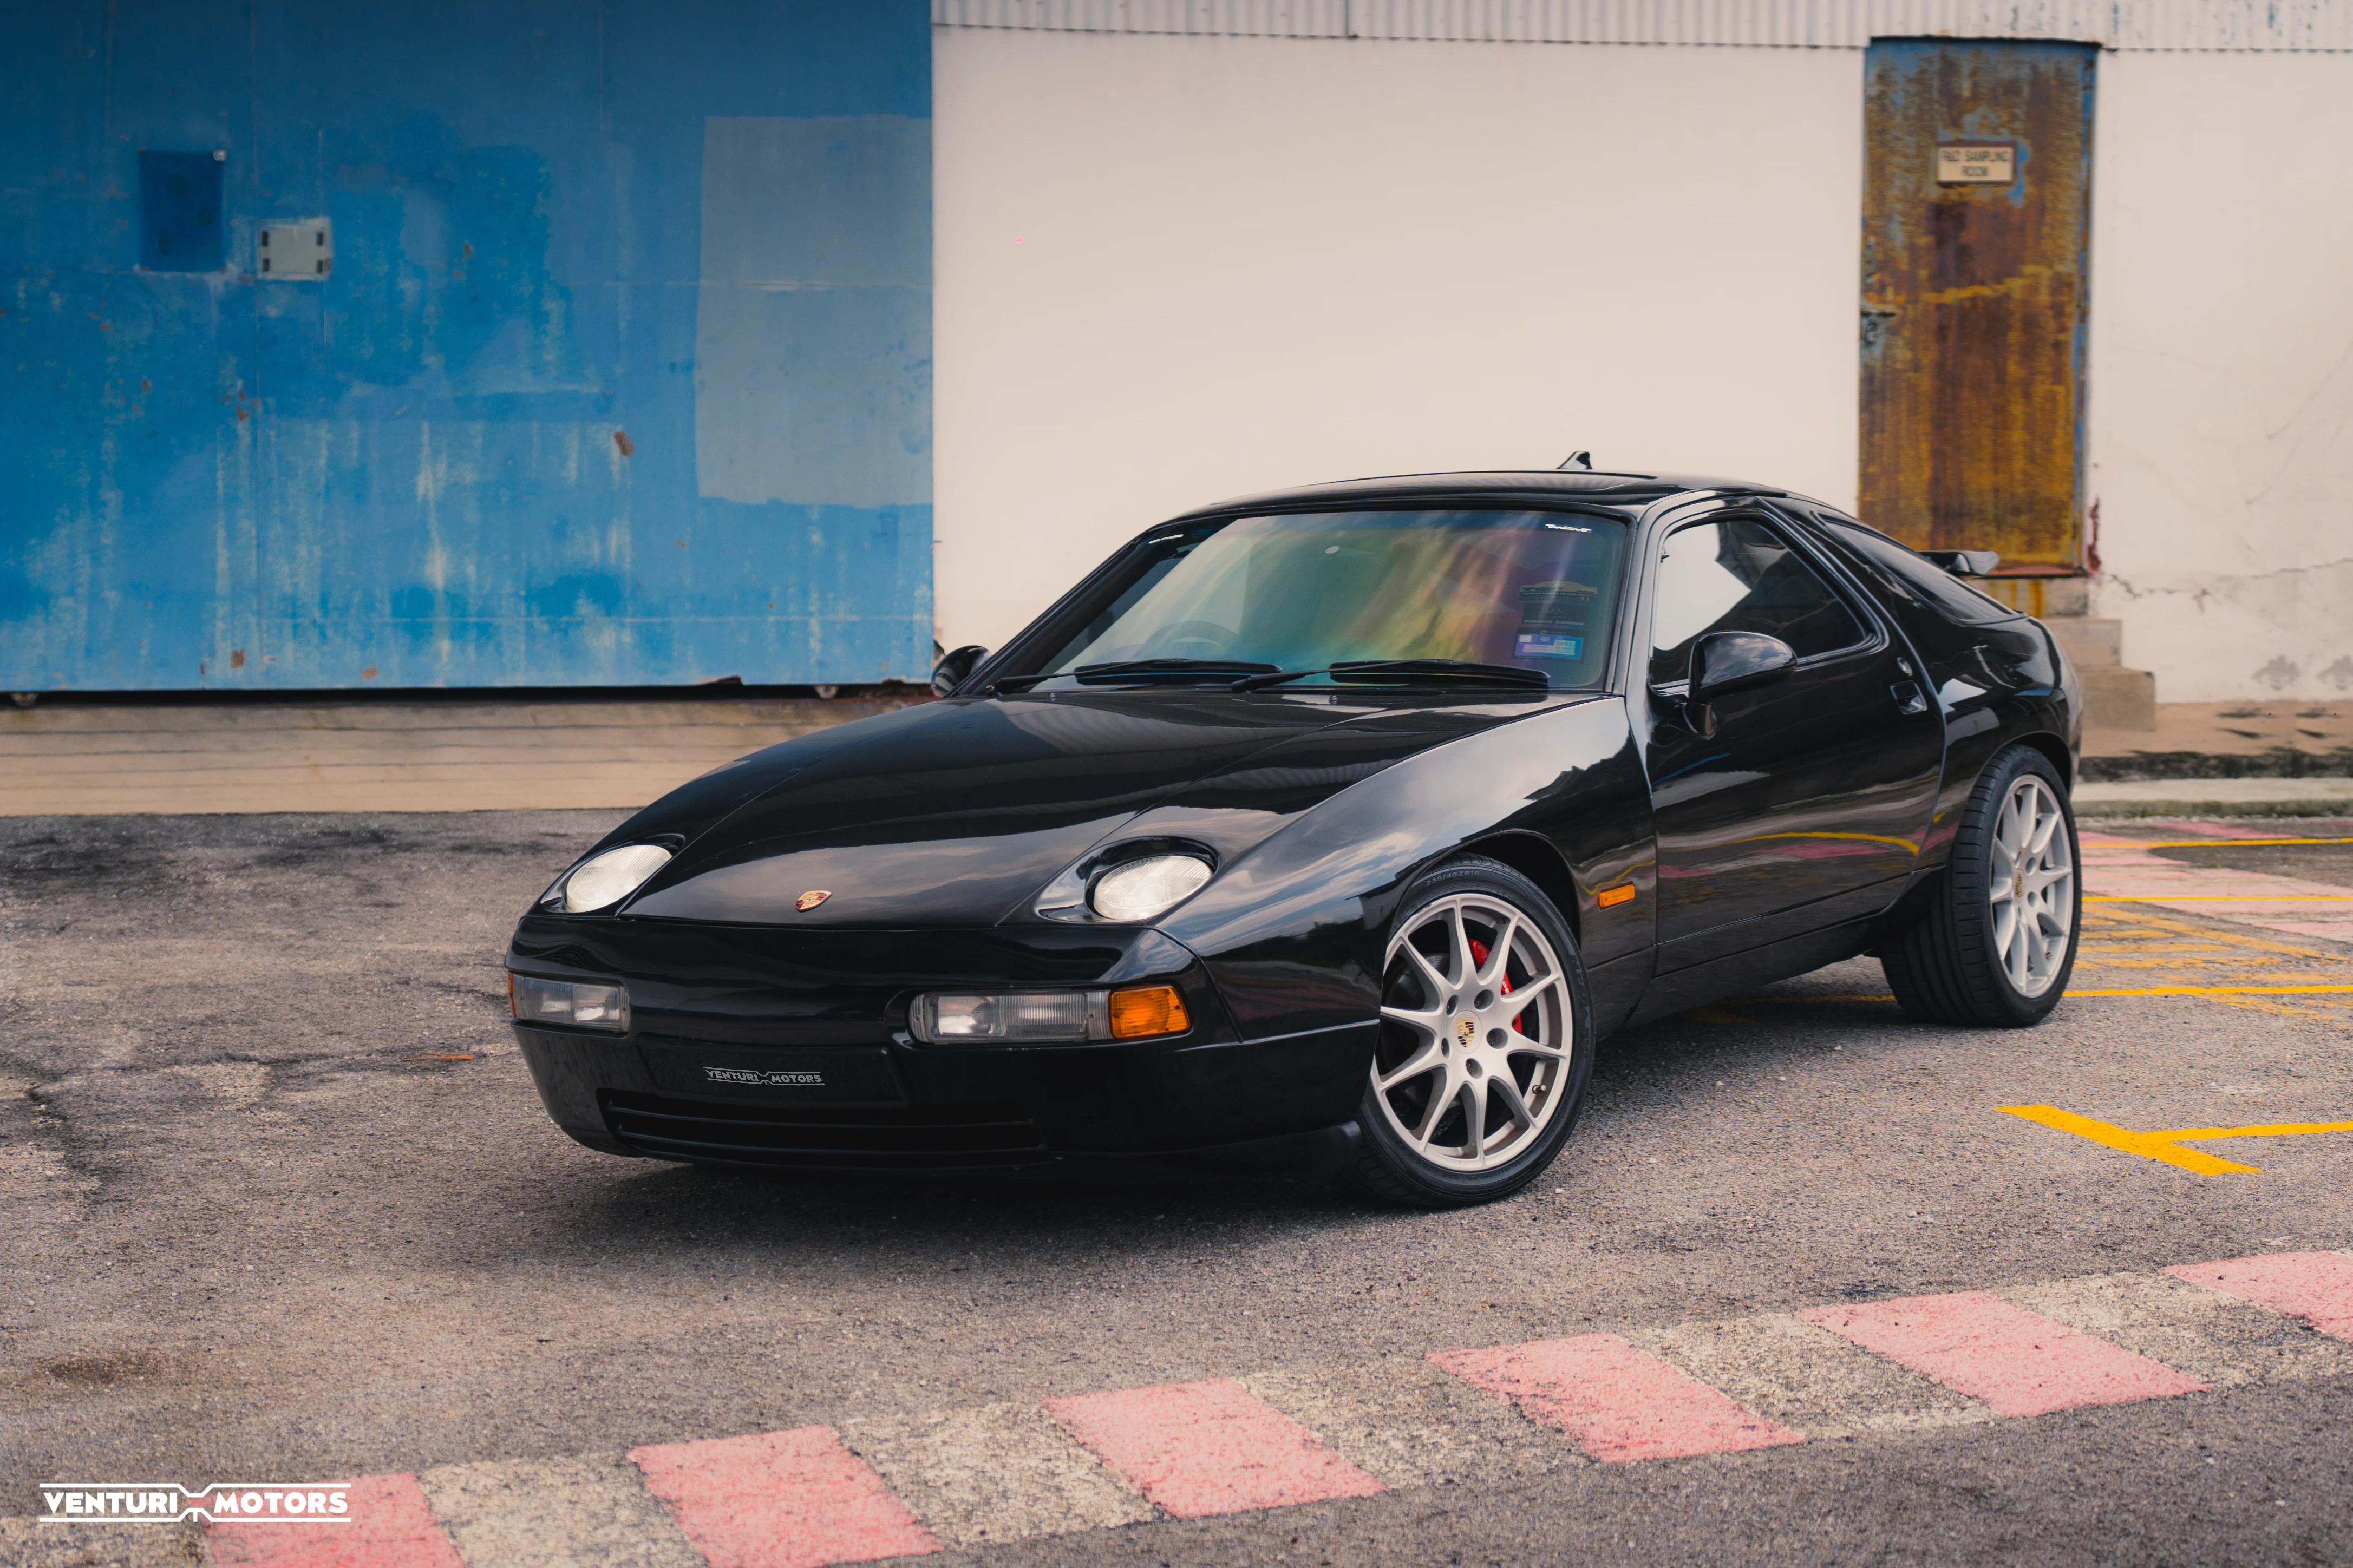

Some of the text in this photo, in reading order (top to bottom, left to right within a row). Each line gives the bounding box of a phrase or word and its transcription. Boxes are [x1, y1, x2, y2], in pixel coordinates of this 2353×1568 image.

[1426, 871, 1480, 887] 235/40ZR18
[705, 1070, 822, 1082] VENTURI MOTORS
